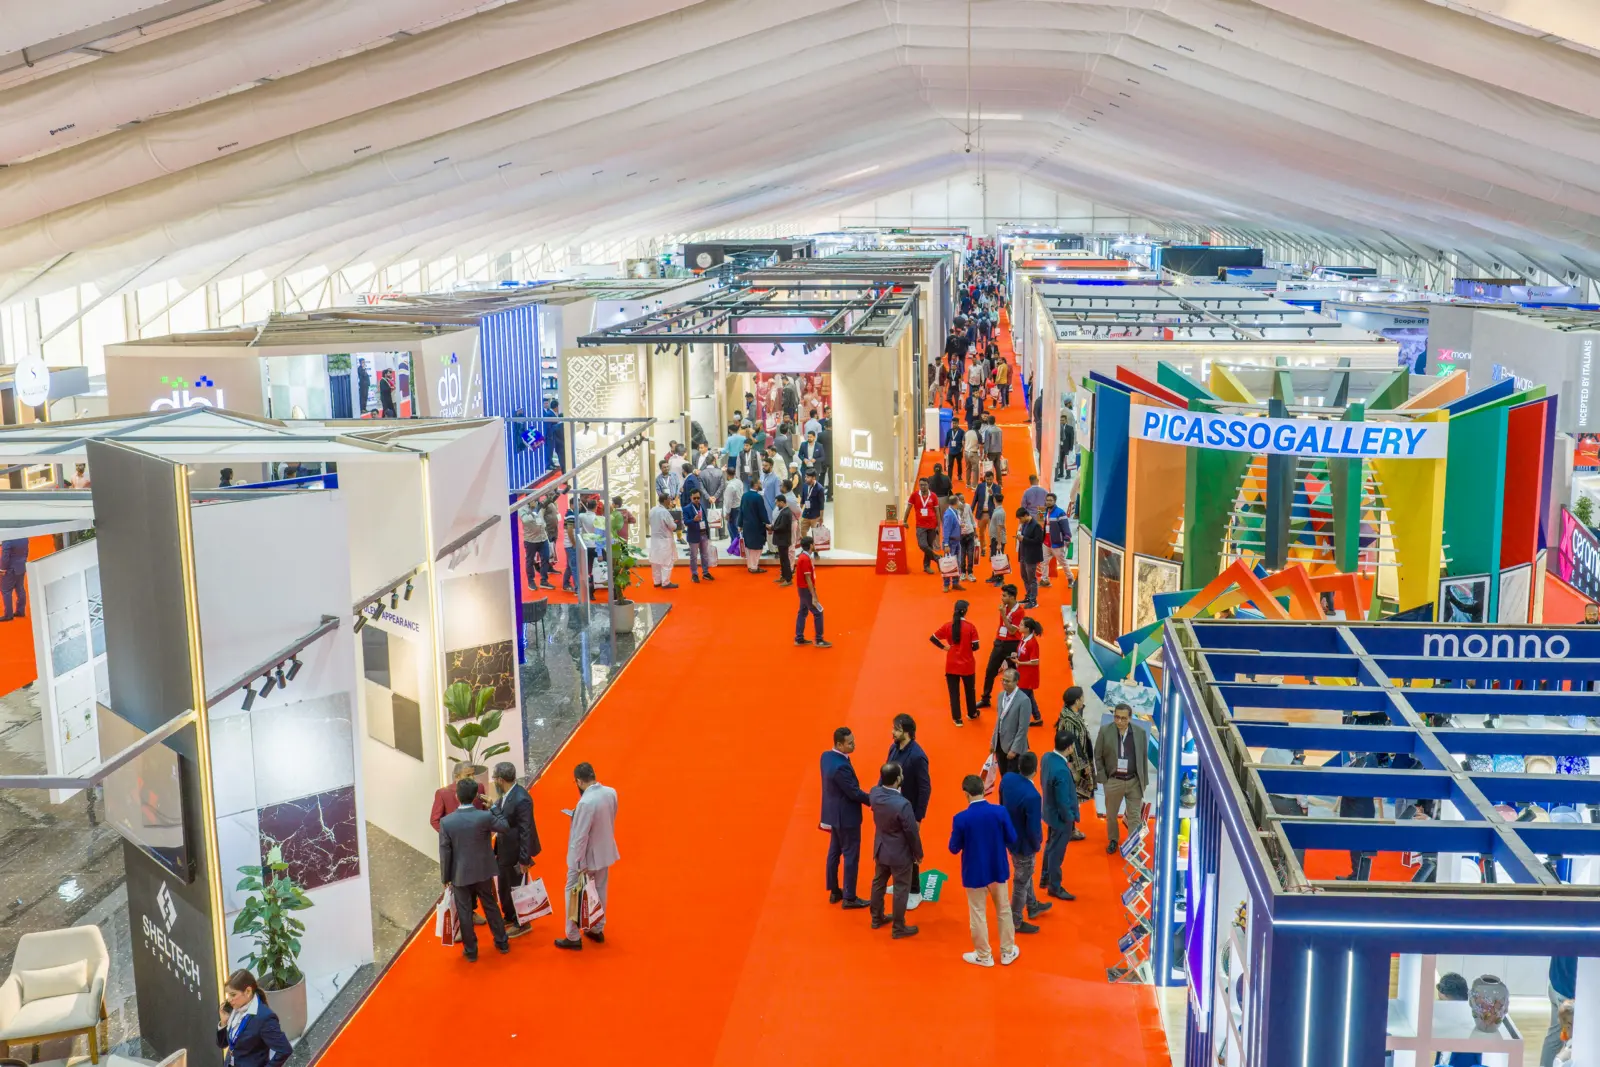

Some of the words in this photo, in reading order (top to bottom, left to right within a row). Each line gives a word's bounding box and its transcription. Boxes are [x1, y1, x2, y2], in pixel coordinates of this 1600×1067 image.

[1583, 340, 1593, 376] ITALIANS
[438, 364, 462, 406] dbl
[1582, 377, 1590, 387] BY
[1579, 388, 1589, 426] INCEPTED
[854, 458, 884, 472] CERAMICS
[381, 611, 420, 632] APPEARANCE
[1423, 634, 1571, 659] monno
[142, 914, 201, 987] SHELTECH
